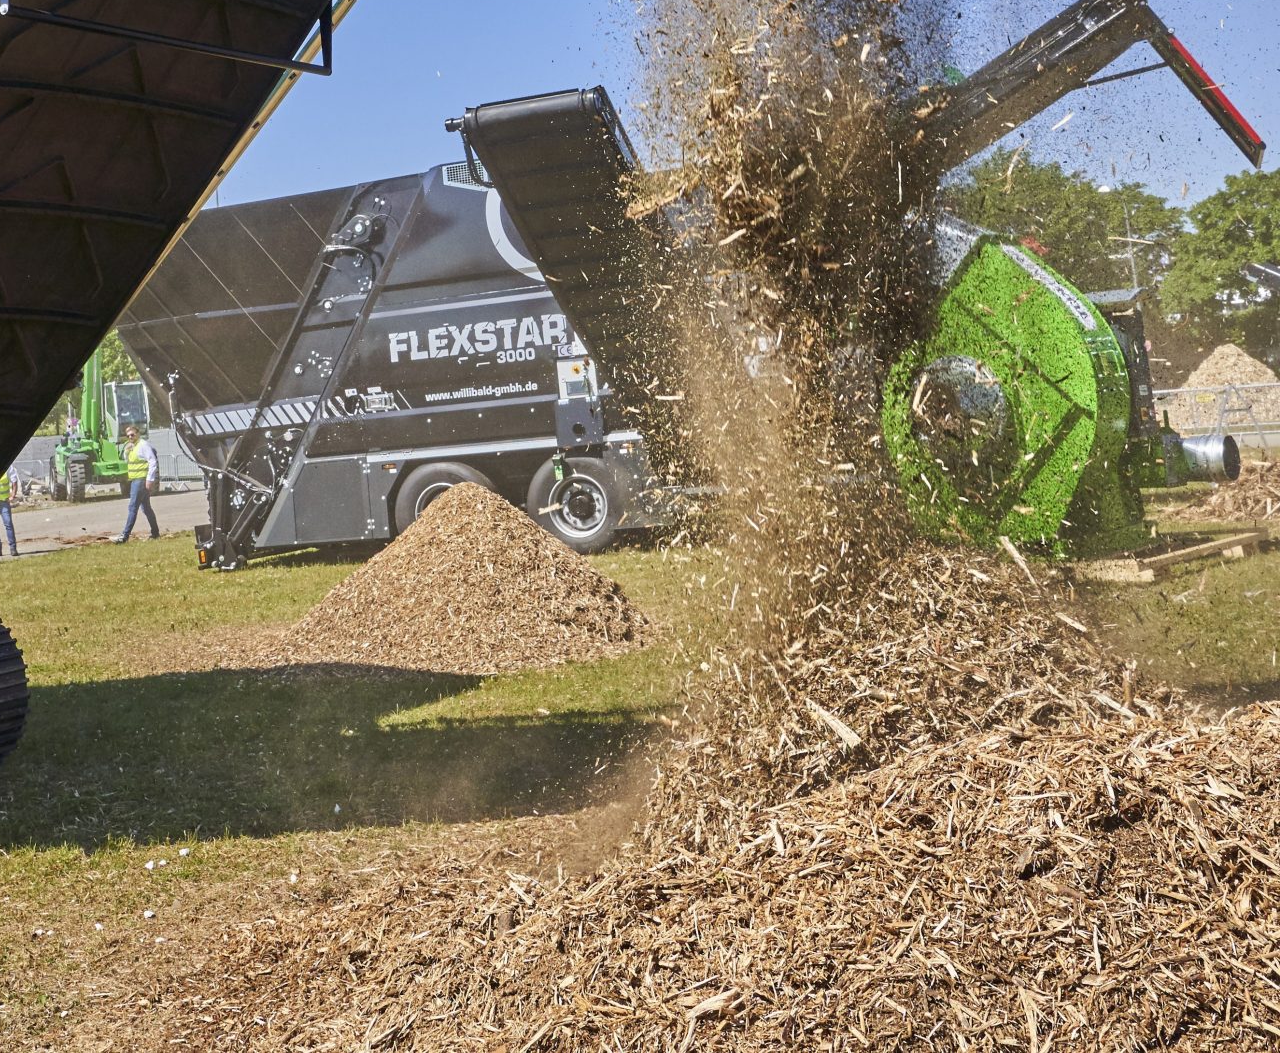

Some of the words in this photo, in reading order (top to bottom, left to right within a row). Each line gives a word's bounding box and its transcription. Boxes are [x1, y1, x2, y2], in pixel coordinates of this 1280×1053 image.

[388, 313, 568, 363] FLEXSTAR
[496, 347, 536, 364] 3000
[560, 345, 573, 356] CE
[425, 380, 538, 402] www.willibald-gmbh.de
